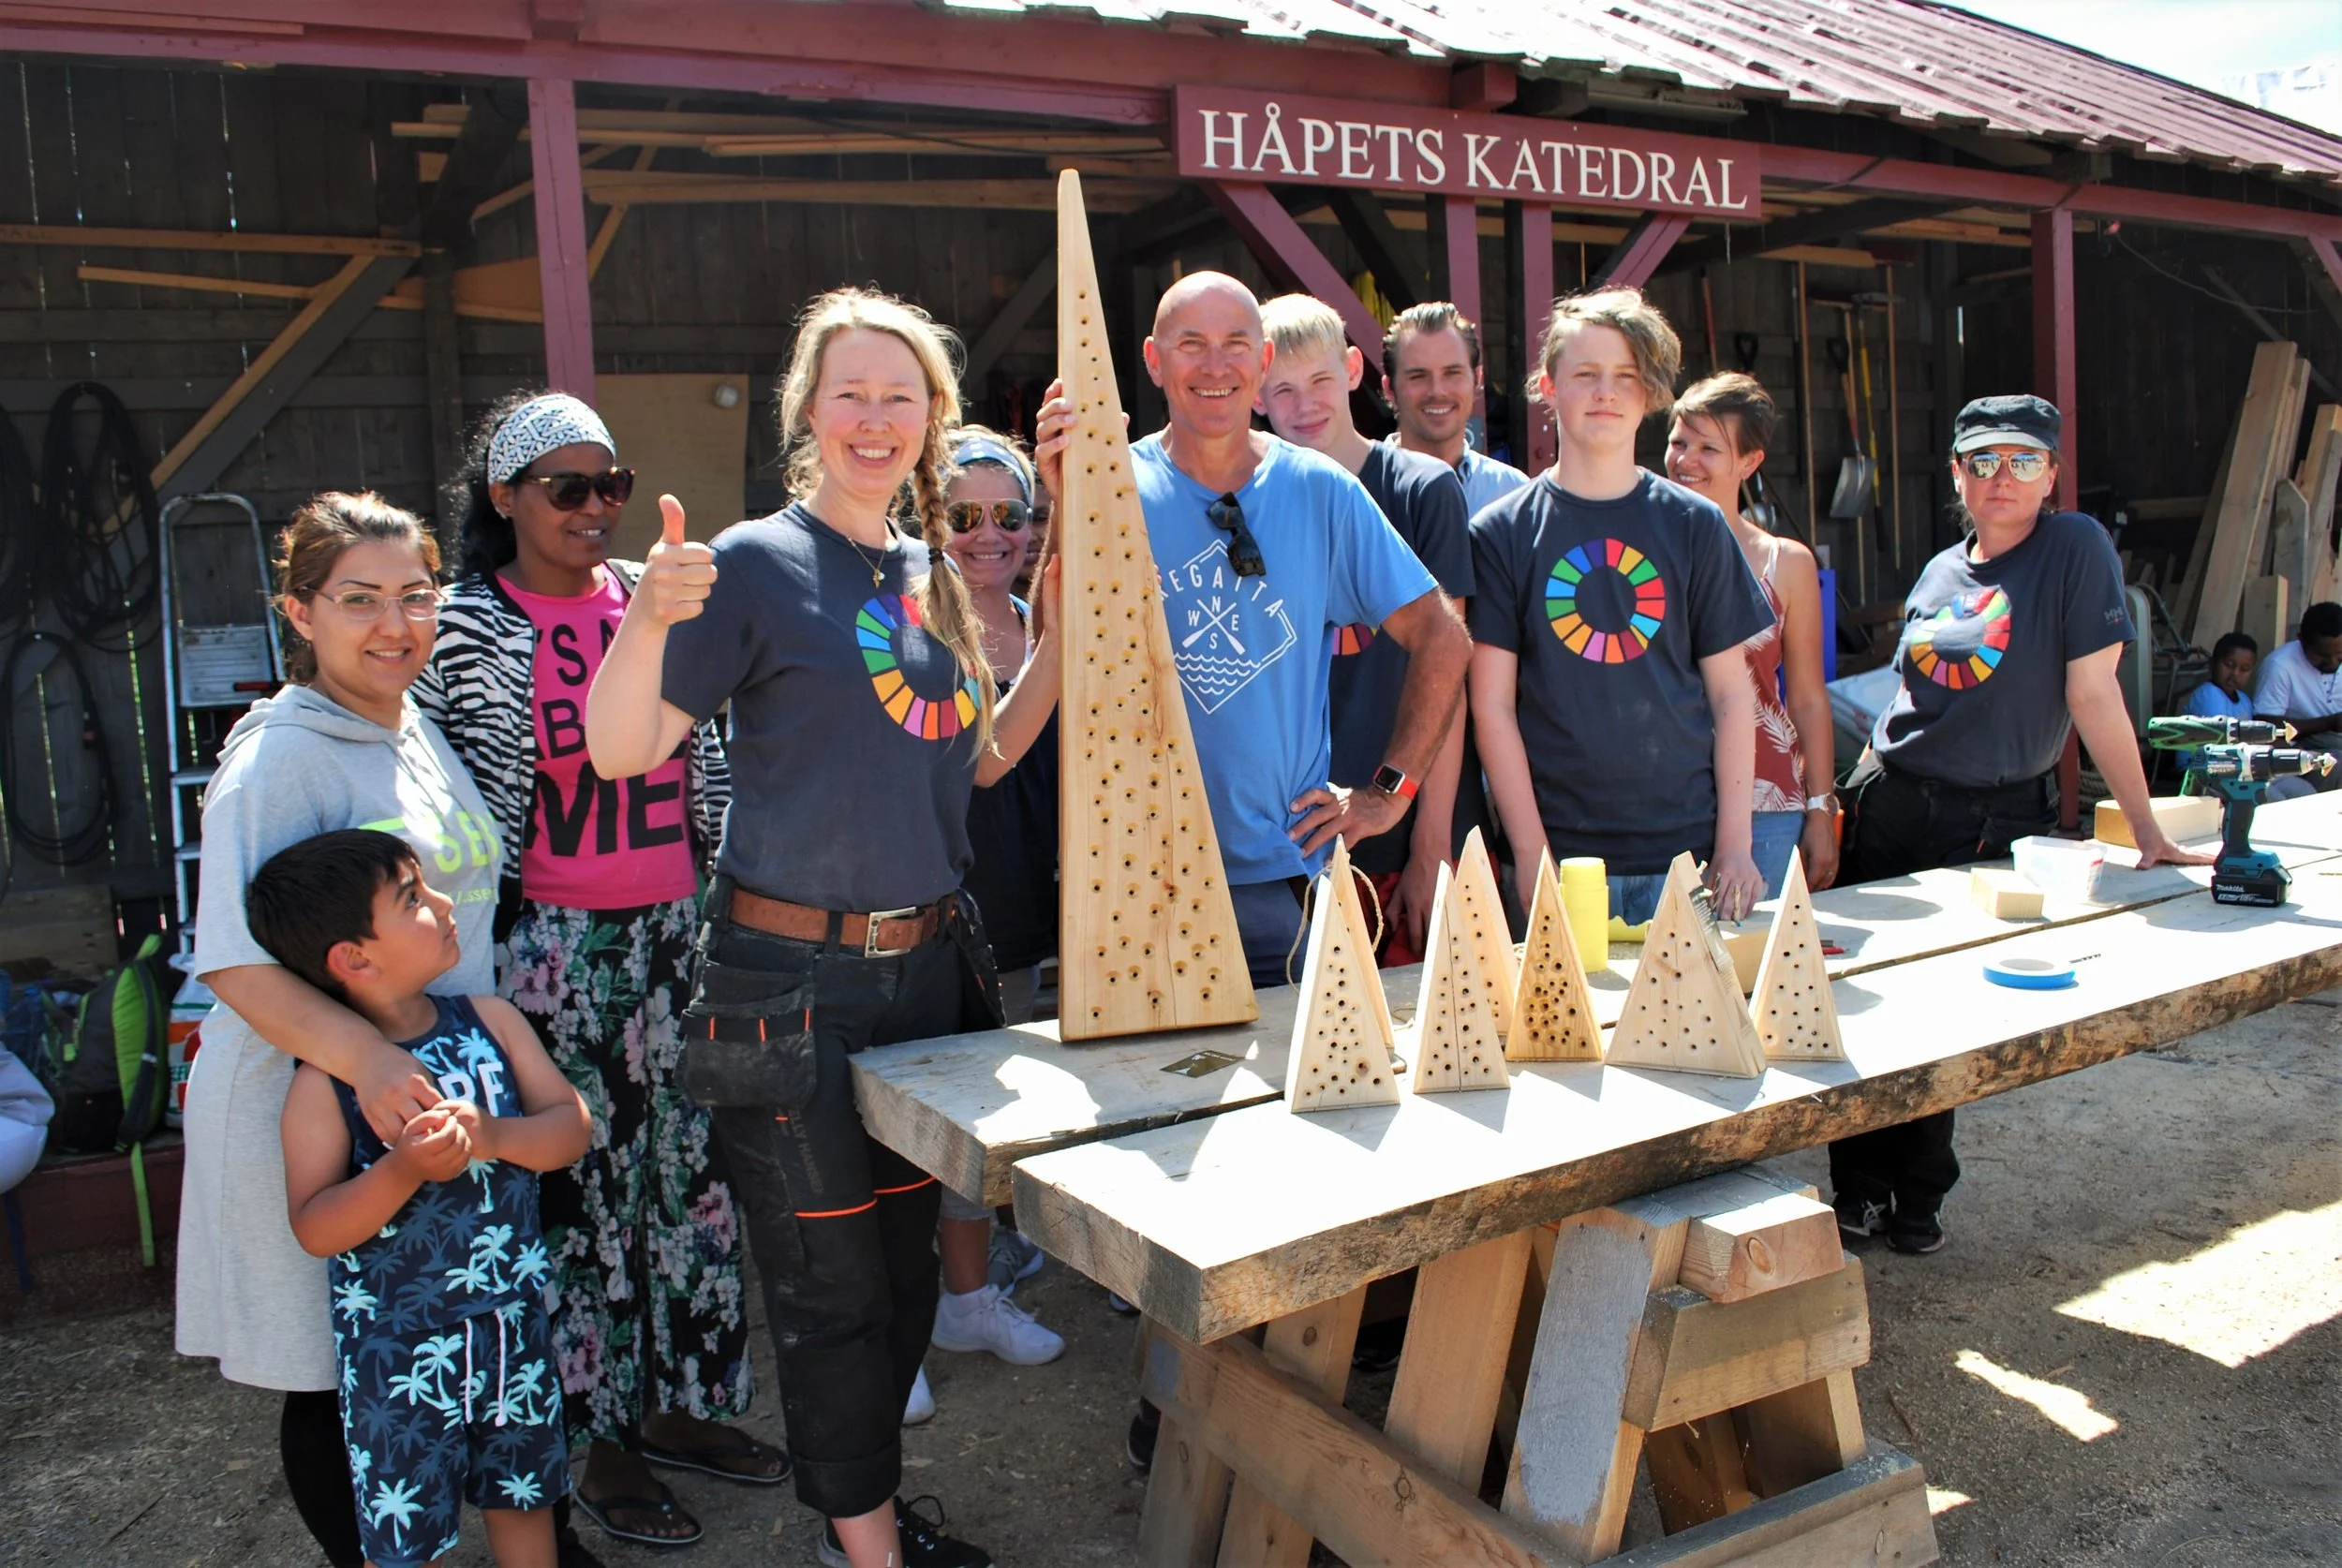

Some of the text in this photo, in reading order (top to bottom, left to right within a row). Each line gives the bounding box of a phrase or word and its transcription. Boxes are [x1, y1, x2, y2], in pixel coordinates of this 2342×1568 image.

[1198, 102, 1748, 211] HÅPETS KATEDRAL
[1188, 610, 1239, 631] W E
[1208, 633, 1218, 650] S
